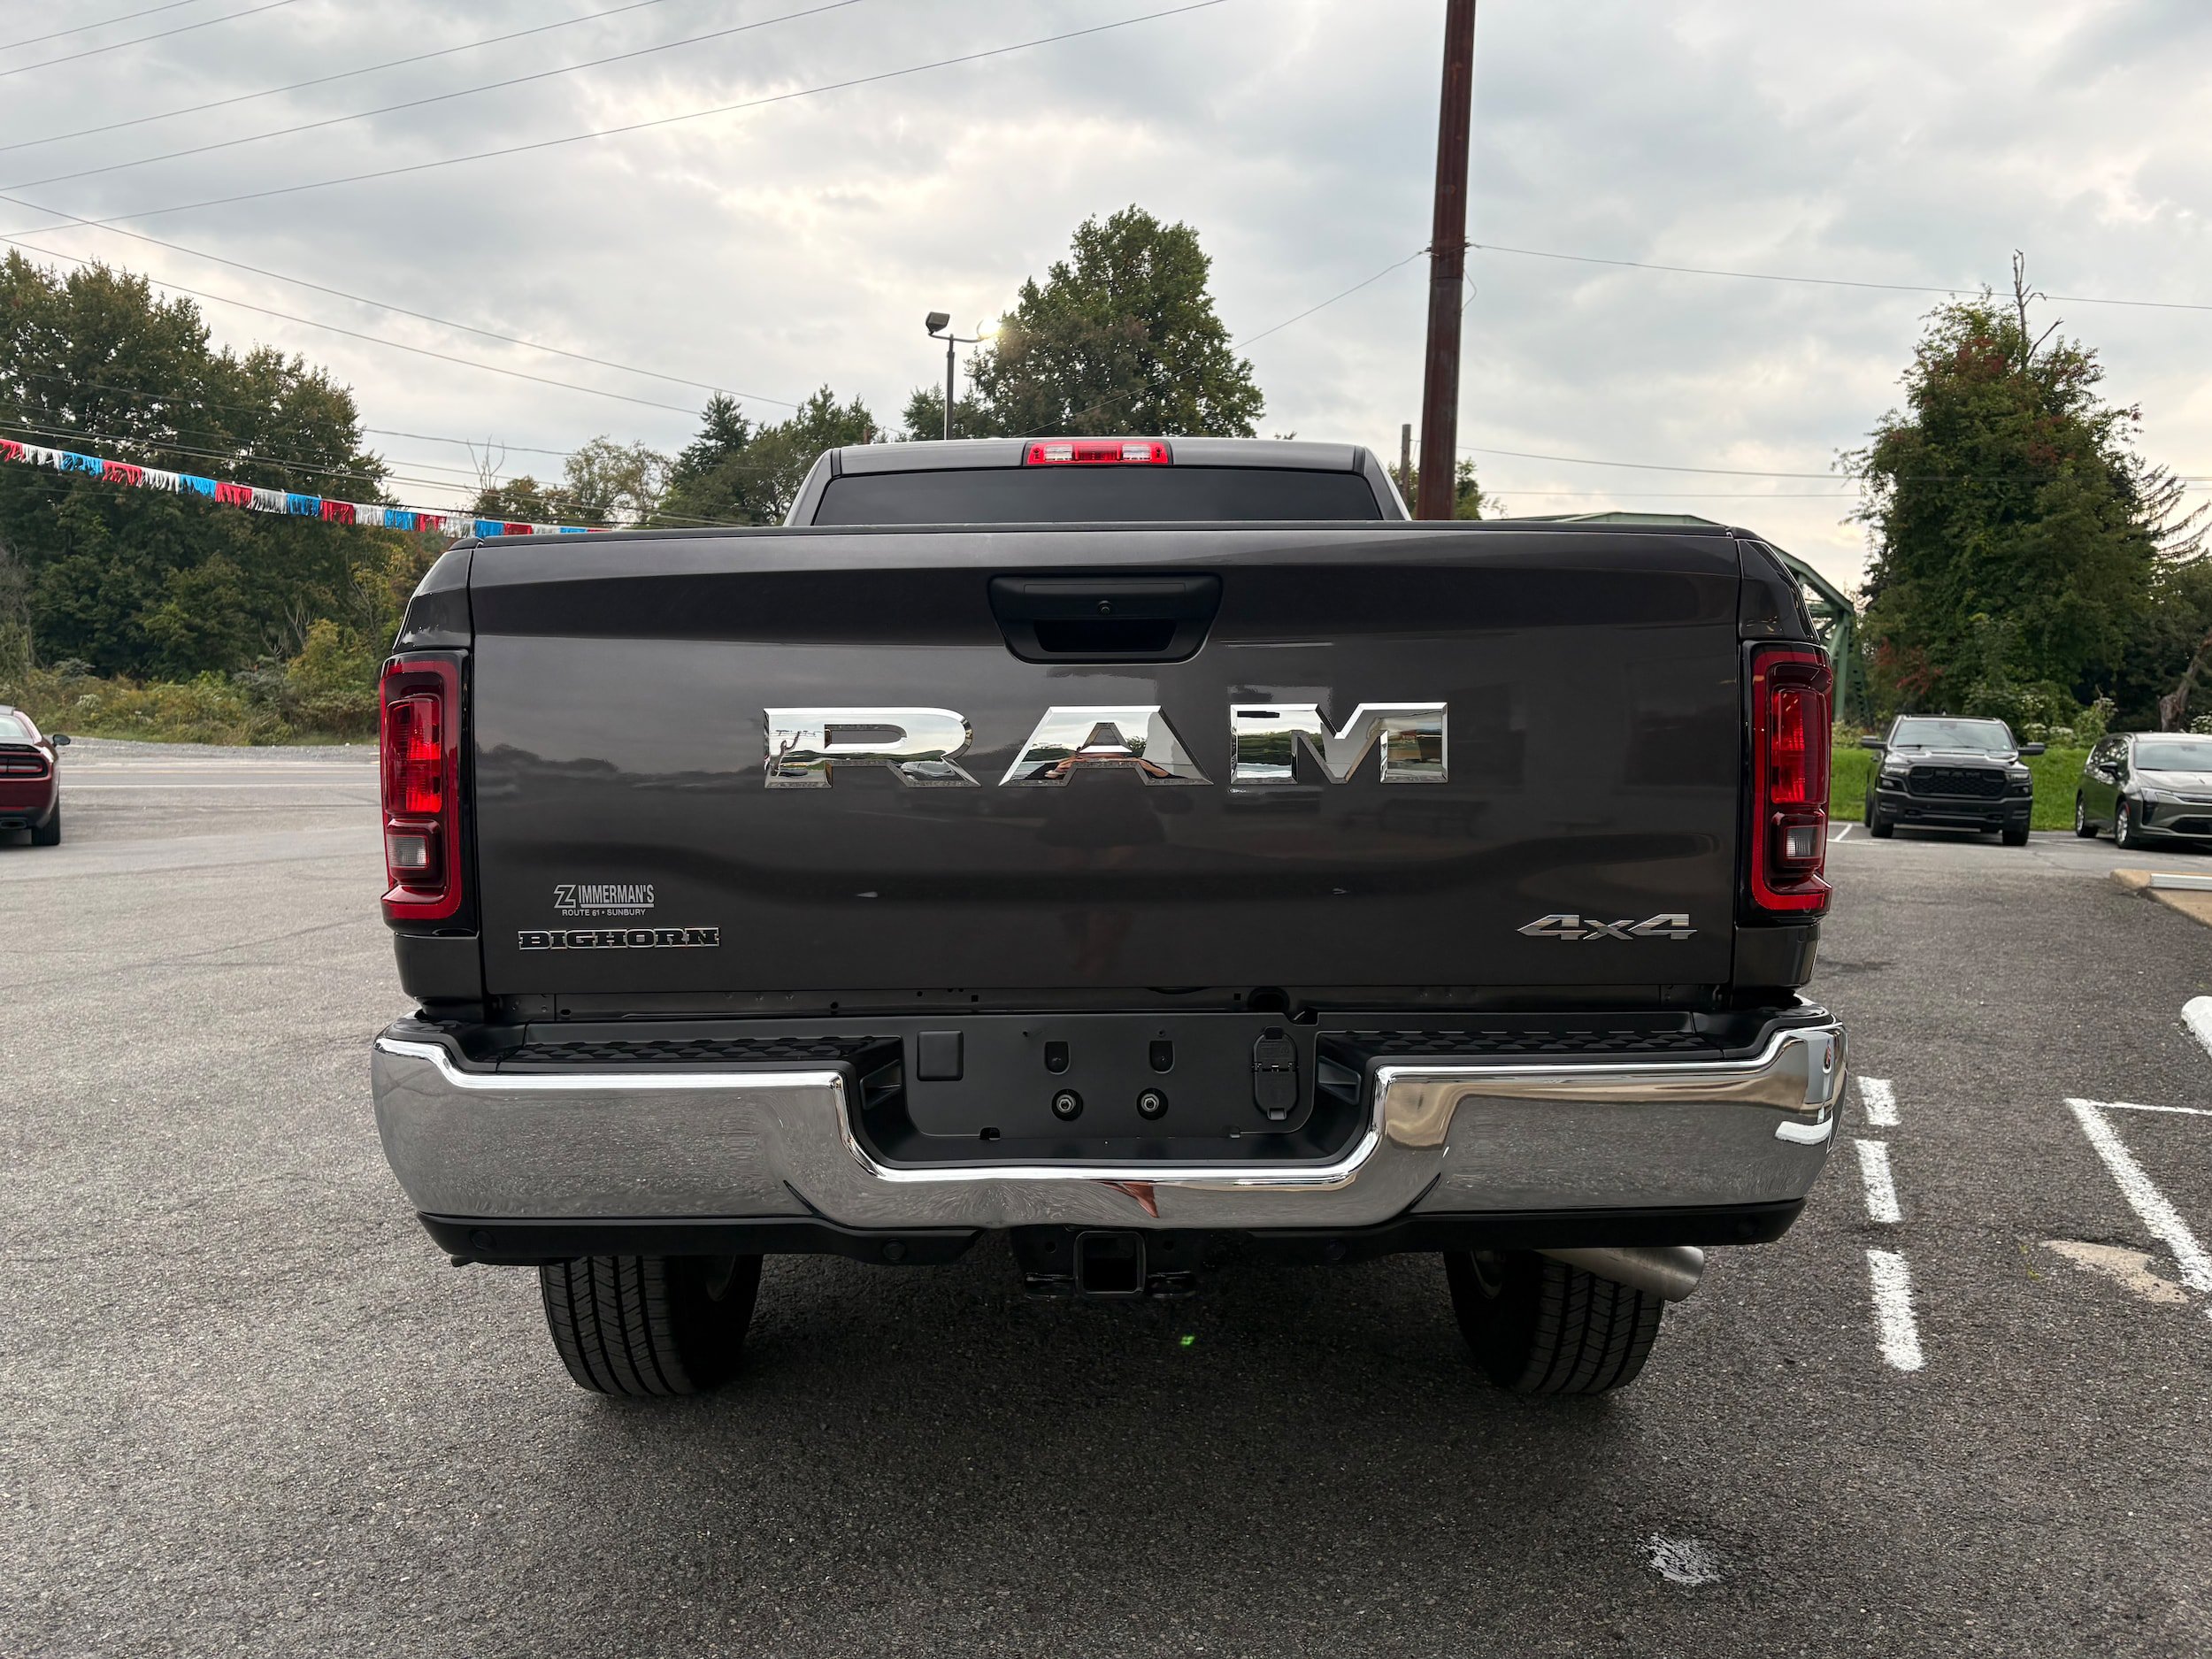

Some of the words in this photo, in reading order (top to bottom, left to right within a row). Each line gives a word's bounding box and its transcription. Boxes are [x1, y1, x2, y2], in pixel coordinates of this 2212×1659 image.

[763, 703, 1449, 788] RAM
[553, 884, 656, 909] ZIMMERMAN'S
[607, 908, 646, 917] SUNBURY
[518, 927, 721, 950] BIGHORN
